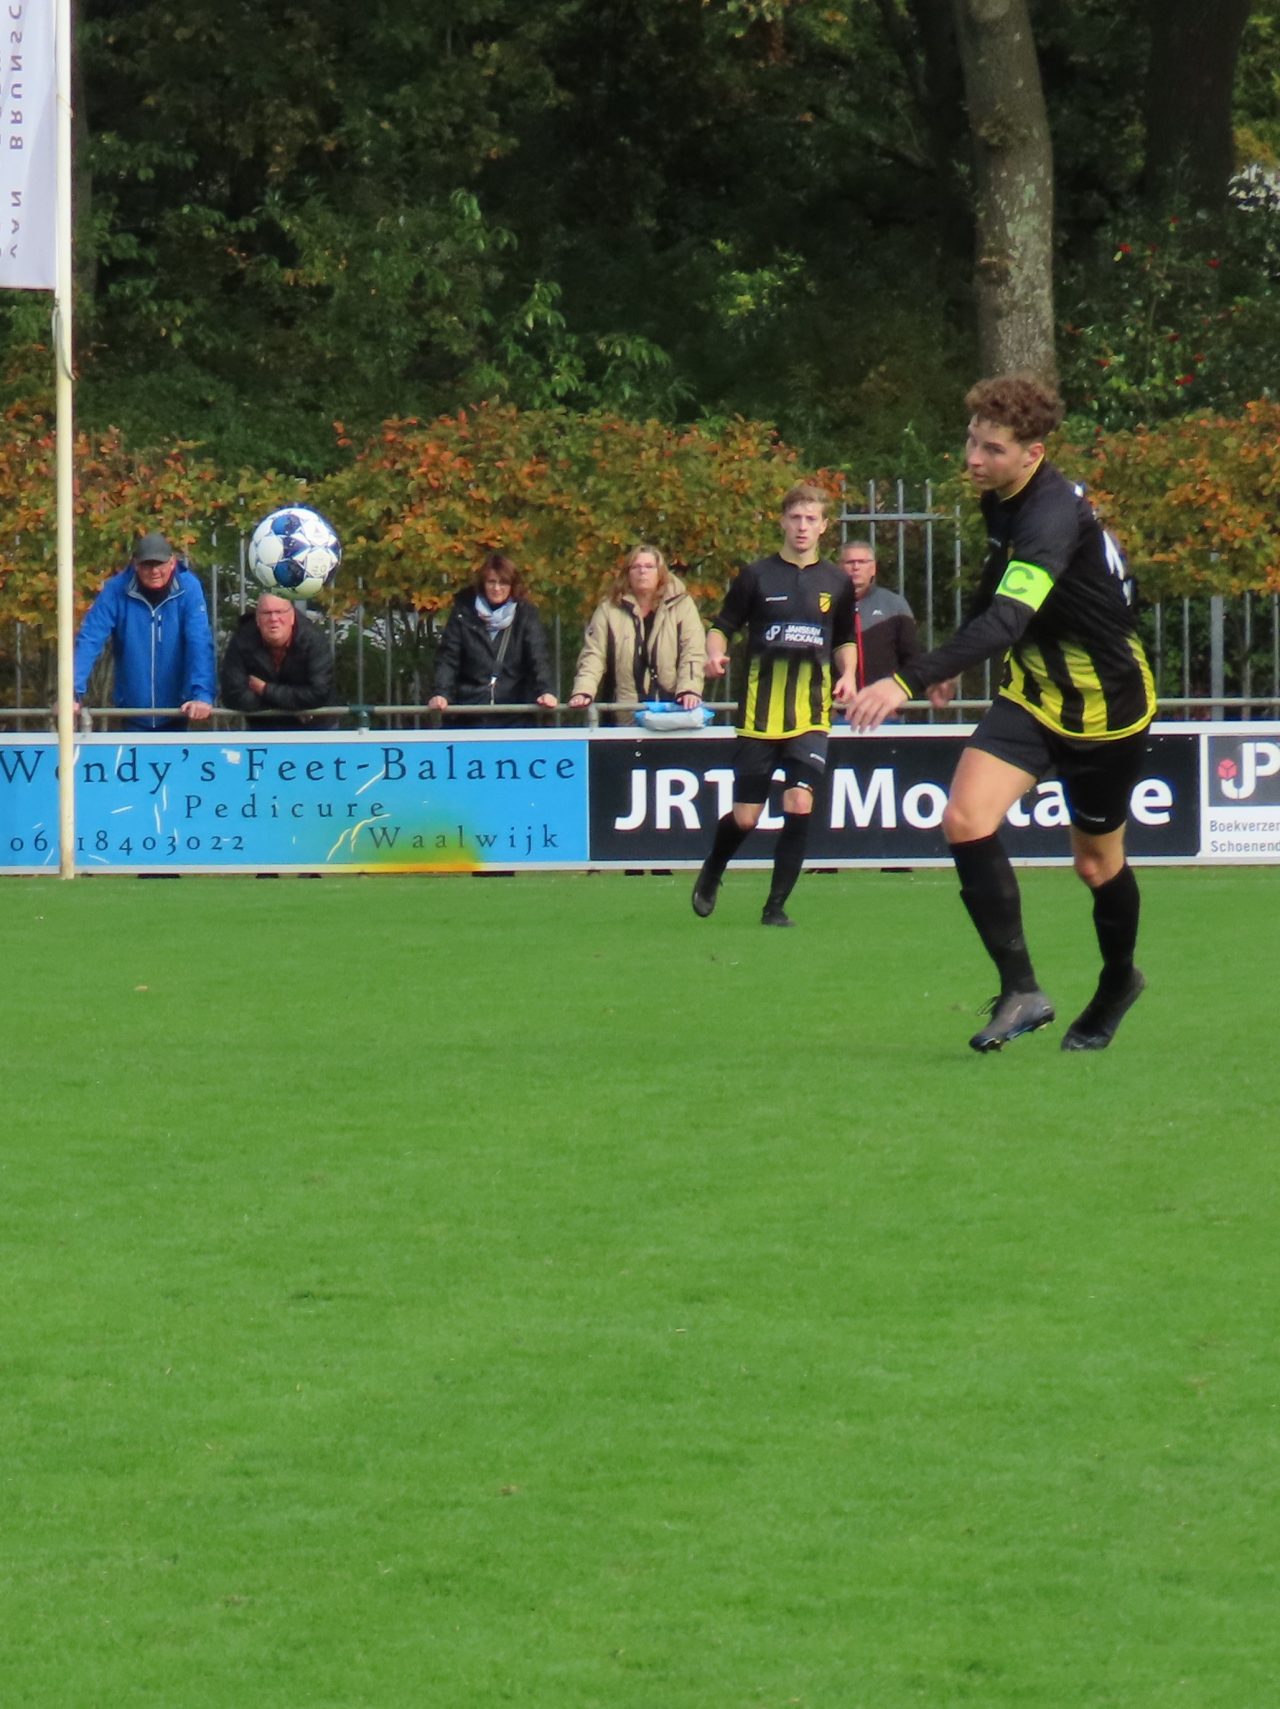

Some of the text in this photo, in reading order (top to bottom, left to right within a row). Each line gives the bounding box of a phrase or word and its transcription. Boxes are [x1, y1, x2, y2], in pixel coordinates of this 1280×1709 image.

[1001, 565, 1034, 595] C
[246, 744, 576, 781] Feet-Balance
[185, 786, 384, 819] Pedicure
[369, 824, 559, 856] Waalwijk
